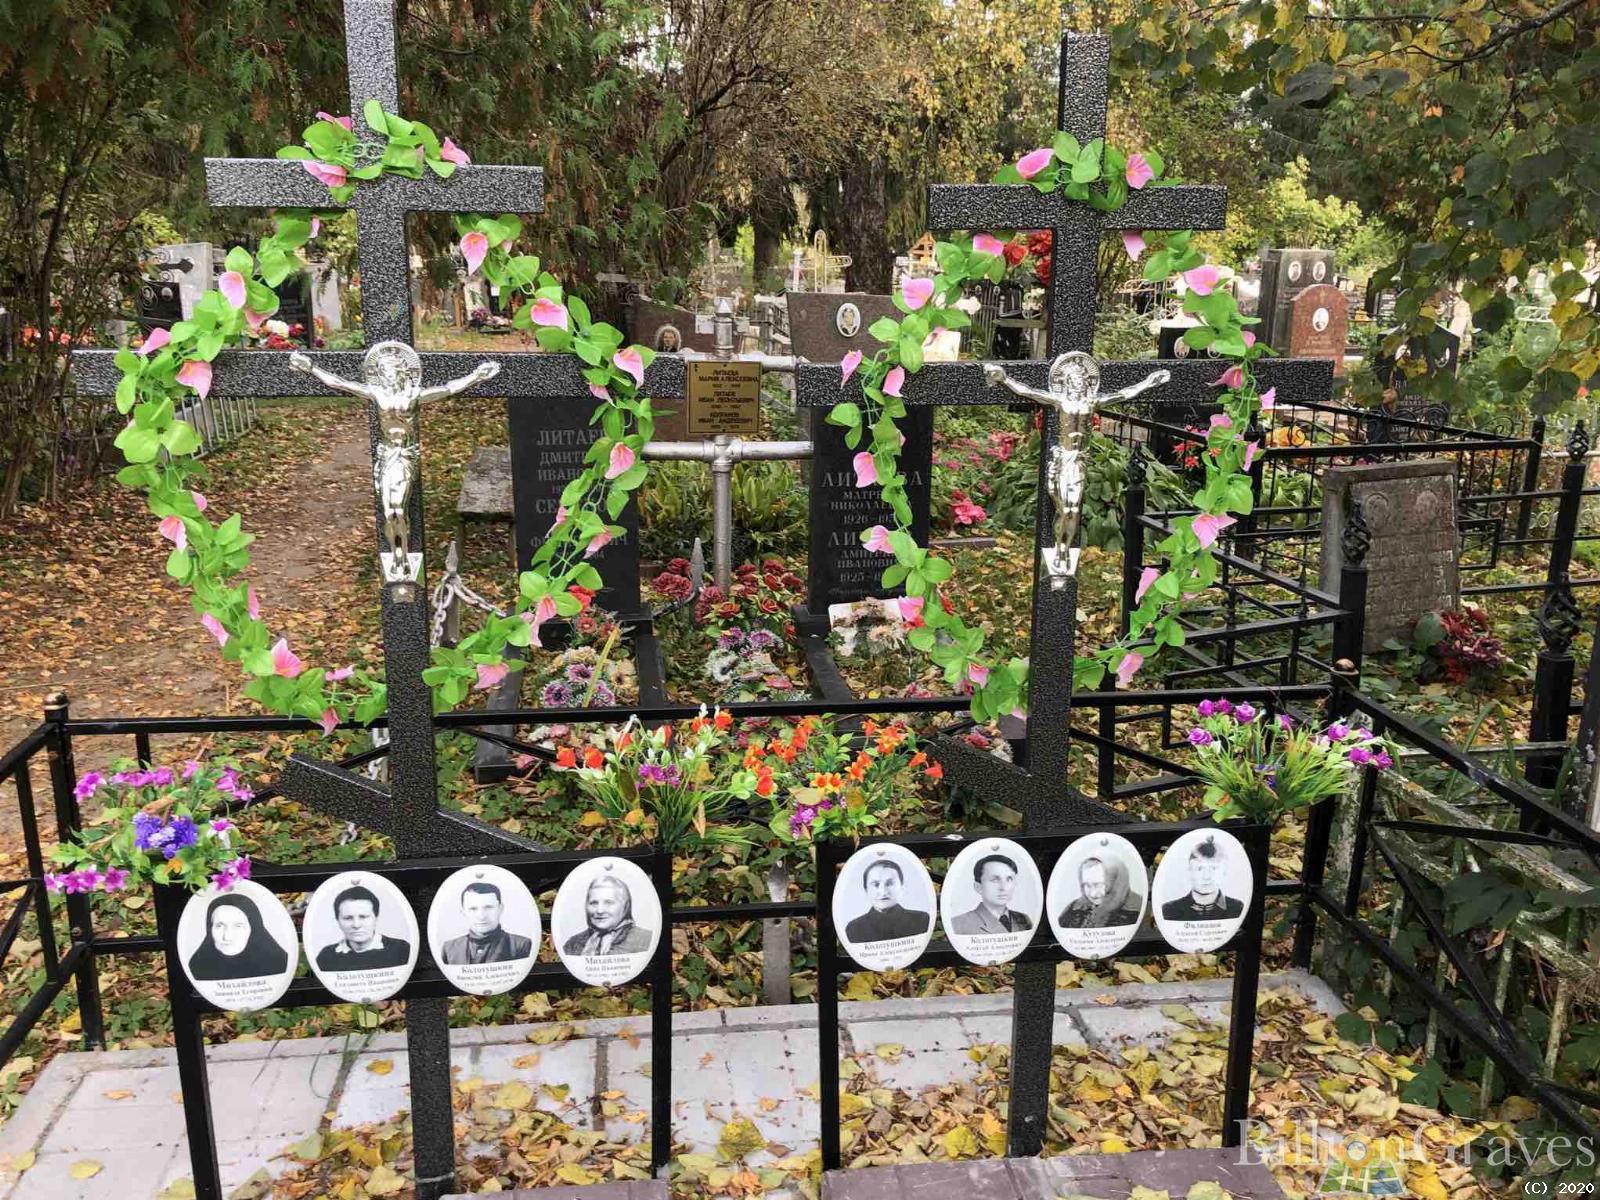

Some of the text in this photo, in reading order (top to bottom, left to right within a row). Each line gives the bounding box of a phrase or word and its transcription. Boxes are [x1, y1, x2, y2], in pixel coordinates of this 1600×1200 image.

[537, 429, 604, 446] ЛИТАЕ
[540, 450, 587, 466] ДМИТ
[537, 468, 583, 481] ИВАН
[843, 490, 882, 500] МАТРЕ
[831, 500, 893, 511] НИКОЛАЕ
[584, 957, 630, 965] Михайлова
[216, 979, 267, 989] Михайлова
